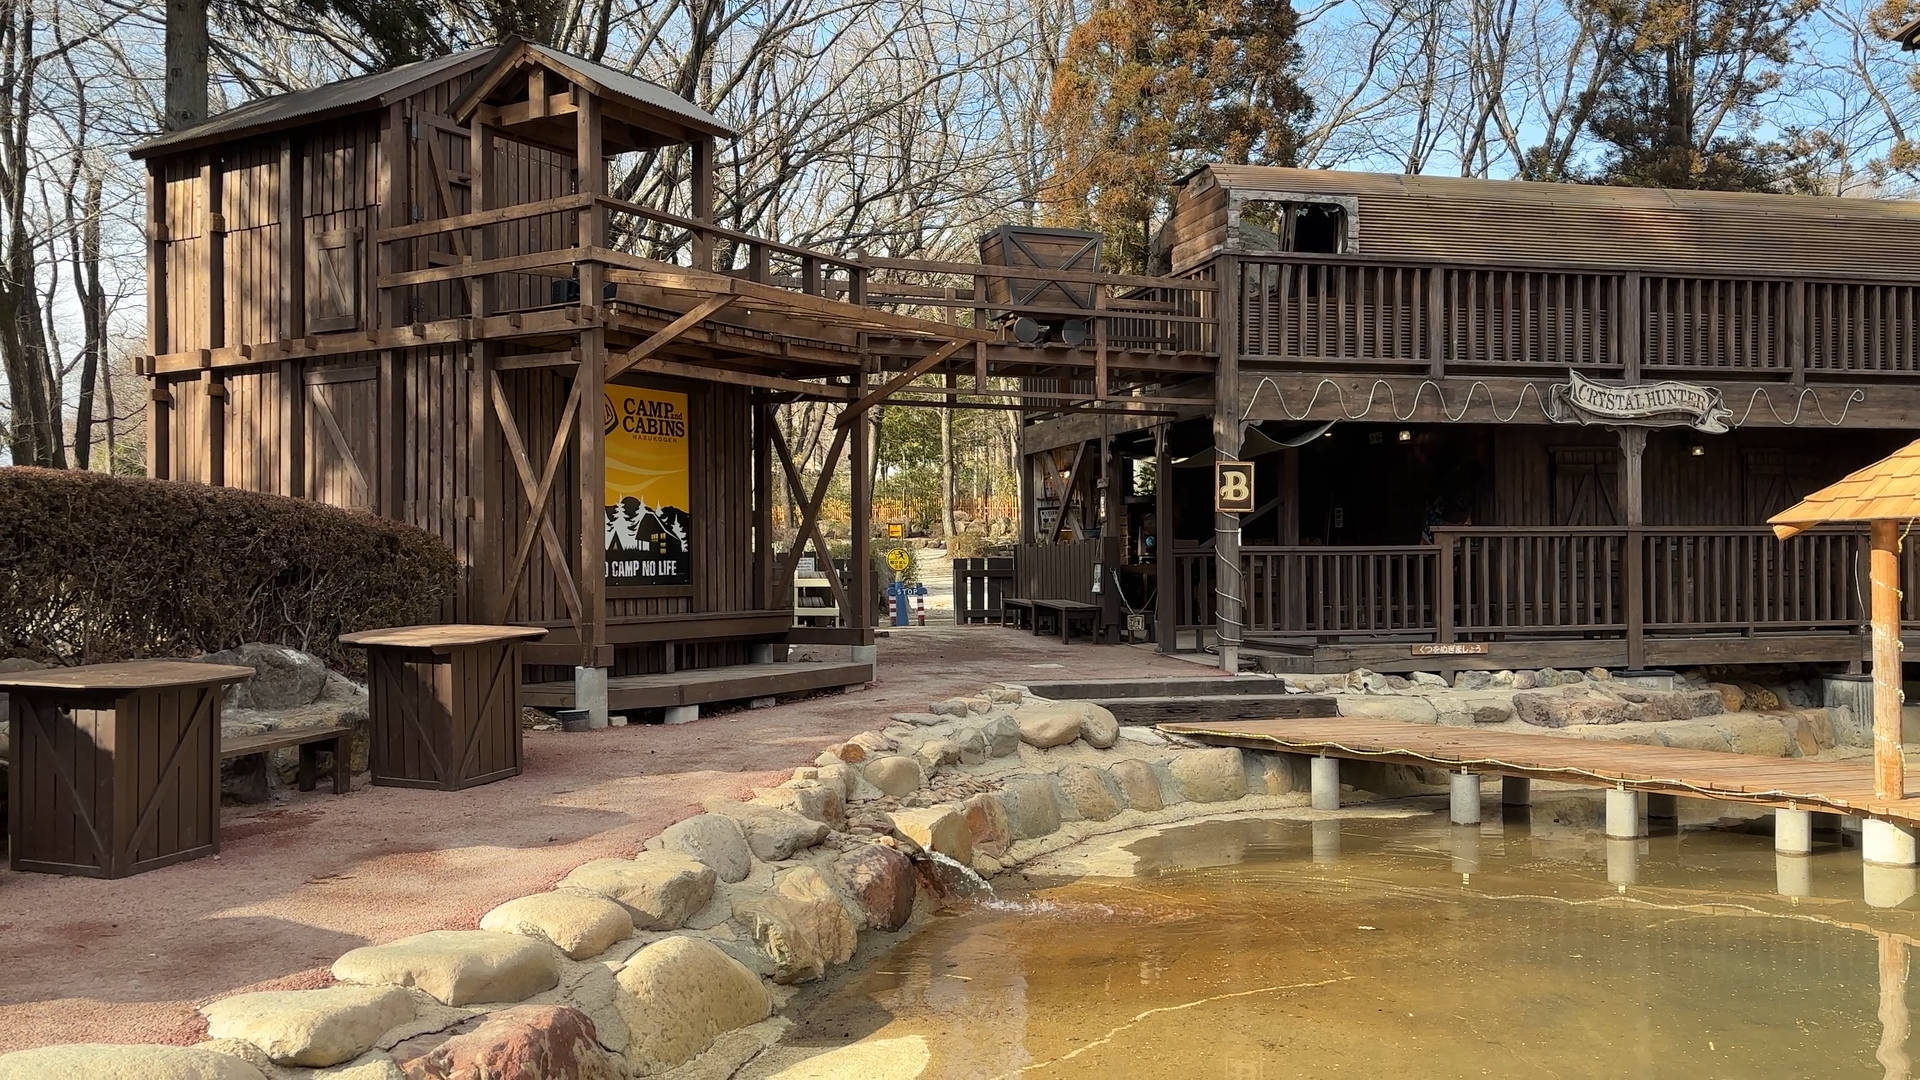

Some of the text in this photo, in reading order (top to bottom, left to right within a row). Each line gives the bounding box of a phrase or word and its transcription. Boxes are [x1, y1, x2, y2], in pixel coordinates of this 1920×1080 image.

[1578, 384, 1707, 411] CRYSTAL HUNTER
[624, 398, 683, 420] CAMP and
[623, 416, 685, 438] CABINS
[1220, 471, 1249, 500] B
[611, 560, 640, 577] CAMP
[642, 560, 656, 577] NO
[658, 560, 677, 576] LIFE
